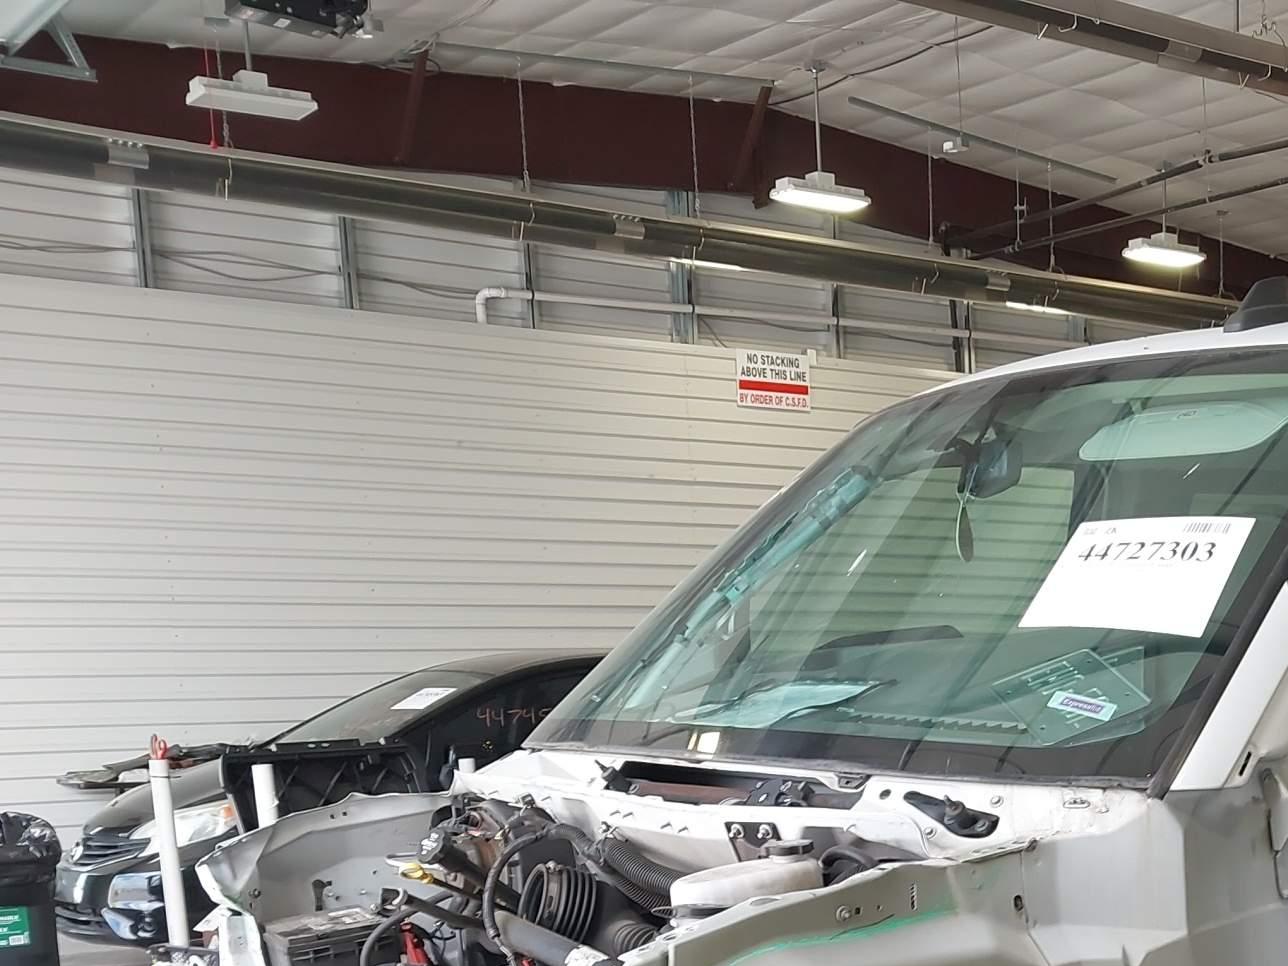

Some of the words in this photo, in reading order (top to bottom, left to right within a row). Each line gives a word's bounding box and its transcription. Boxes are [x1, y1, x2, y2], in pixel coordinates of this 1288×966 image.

[746, 352, 758, 365] NO
[760, 354, 800, 369] STACKING
[740, 366, 768, 378] ABOVE
[769, 368, 788, 381] THIS
[789, 370, 807, 382] LINE
[739, 392, 749, 403] BY
[750, 394, 773, 406] ORDER
[774, 396, 784, 406] OF
[1078, 541, 1217, 562] 44727303
